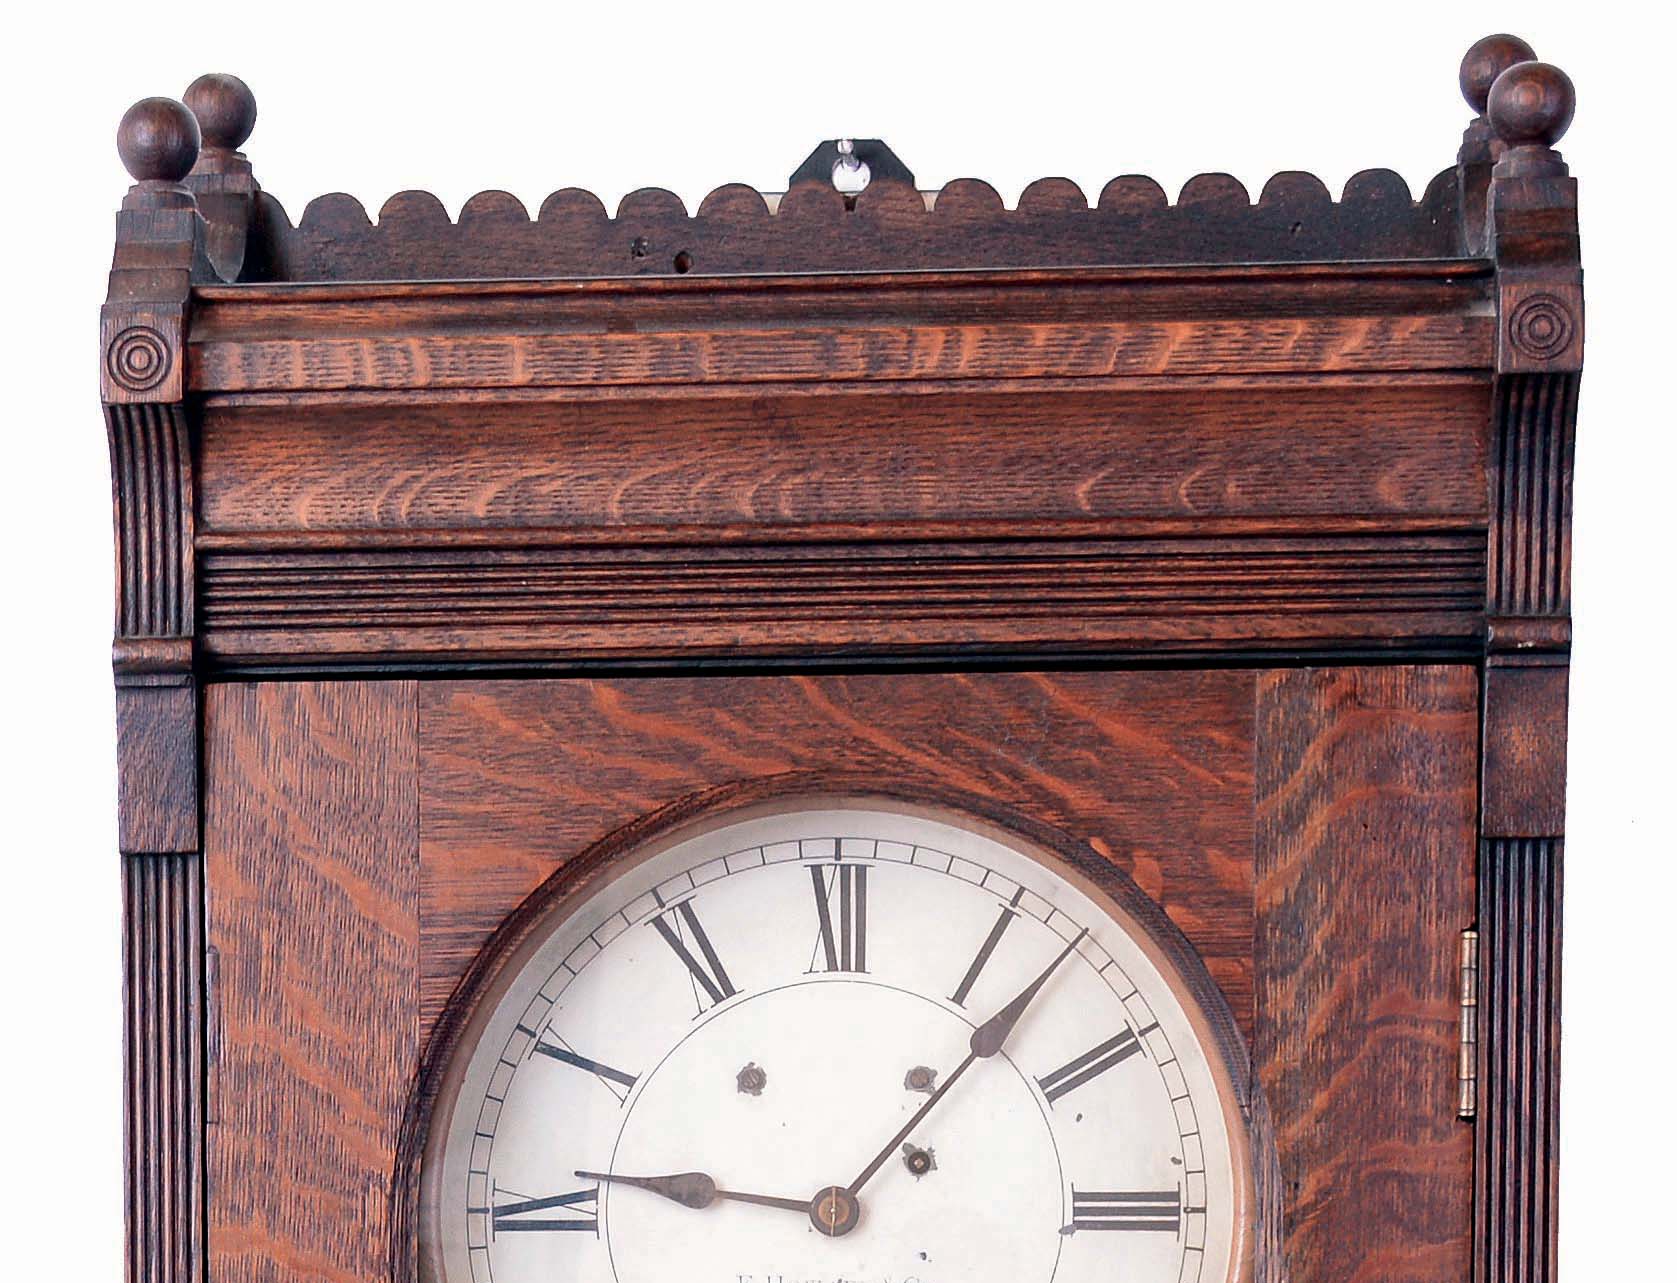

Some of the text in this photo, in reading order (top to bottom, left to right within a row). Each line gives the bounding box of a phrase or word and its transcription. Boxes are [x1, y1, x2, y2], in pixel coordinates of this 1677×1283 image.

[645, 895, 743, 1021] XI
[803, 864, 873, 973] XII
[528, 1020, 641, 1108] X
[1033, 1019, 1149, 1103] II
[492, 1179, 600, 1242] IX
[1071, 1182, 1181, 1241] III
